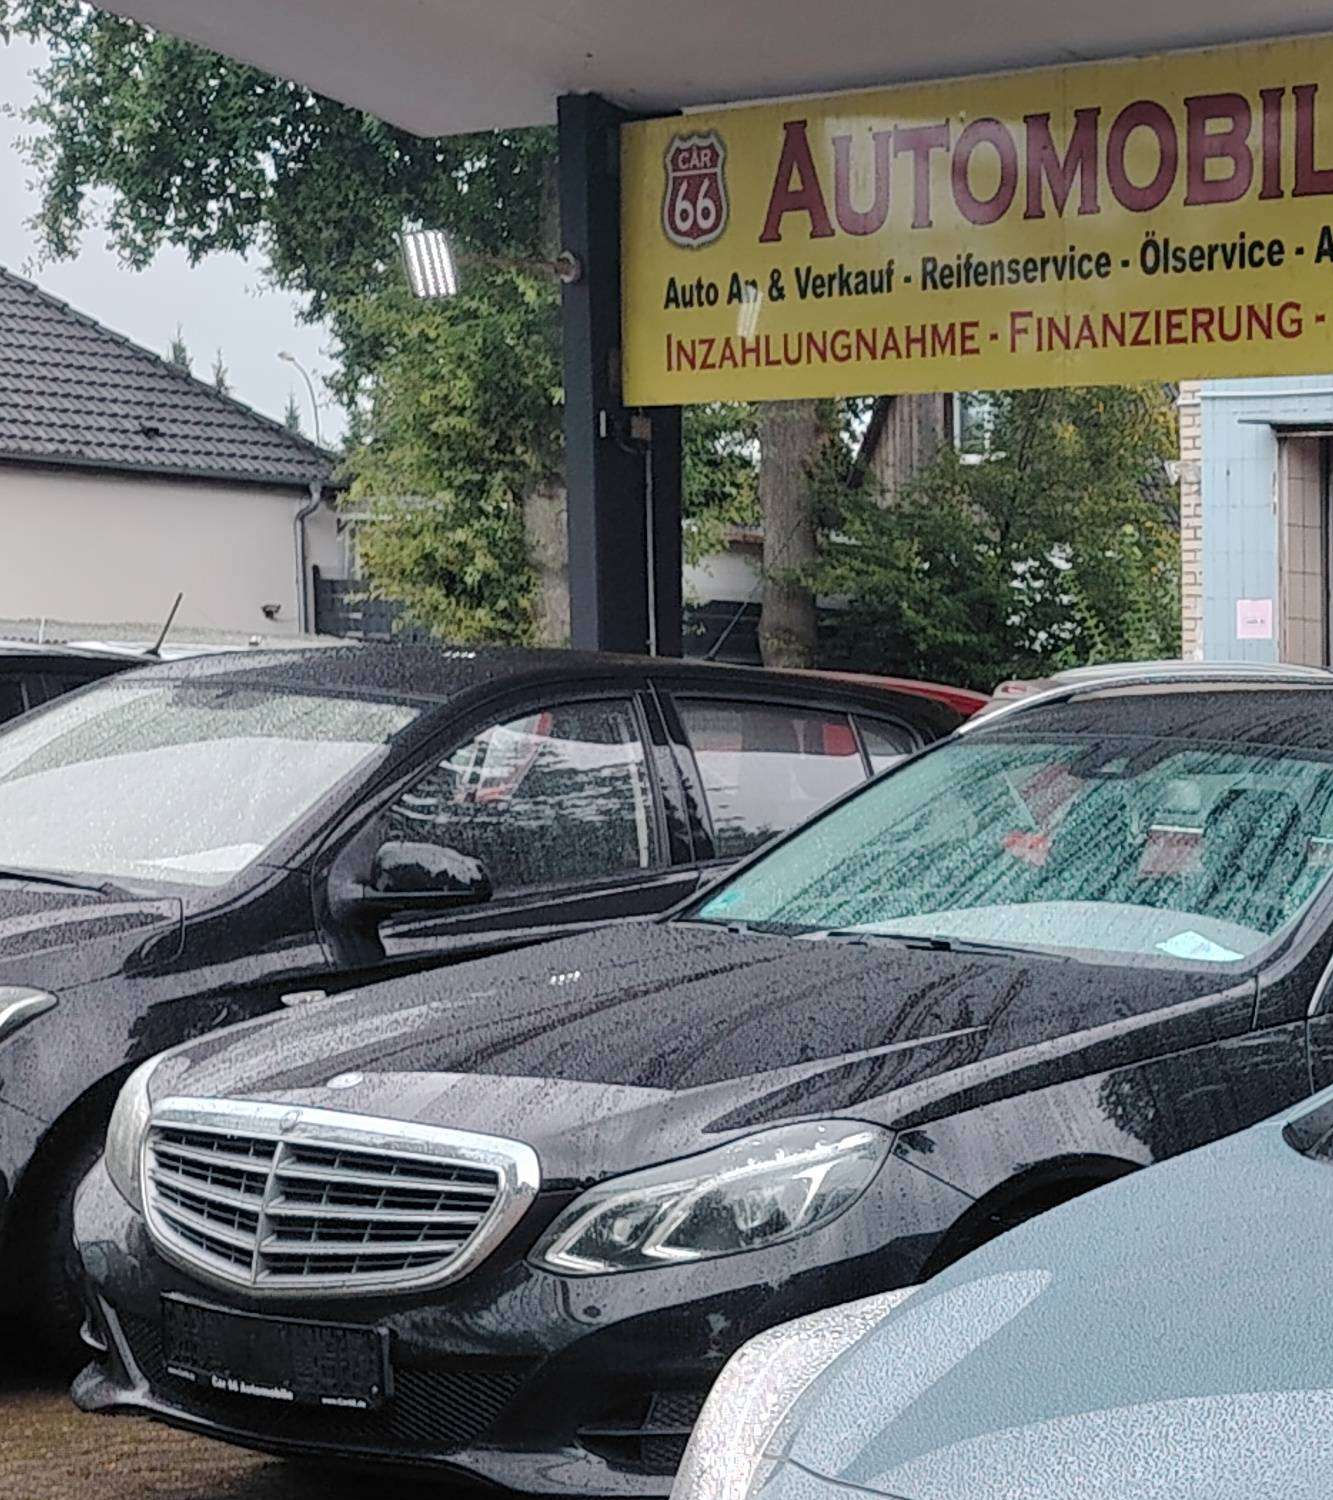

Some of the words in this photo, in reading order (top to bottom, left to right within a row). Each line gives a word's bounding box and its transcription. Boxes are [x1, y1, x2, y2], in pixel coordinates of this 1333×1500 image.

[677, 150, 713, 171] CAR
[674, 179, 717, 231] 66
[664, 277, 719, 310] Auto
[768, 268, 786, 302] &
[794, 259, 895, 301] Verkauf
[921, 245, 1112, 292] Reifenservice
[1140, 230, 1285, 276] Ölservice
[666, 320, 980, 373] INZAHLUNGNAHME
[1009, 301, 1304, 353] FINANZIERUNG
